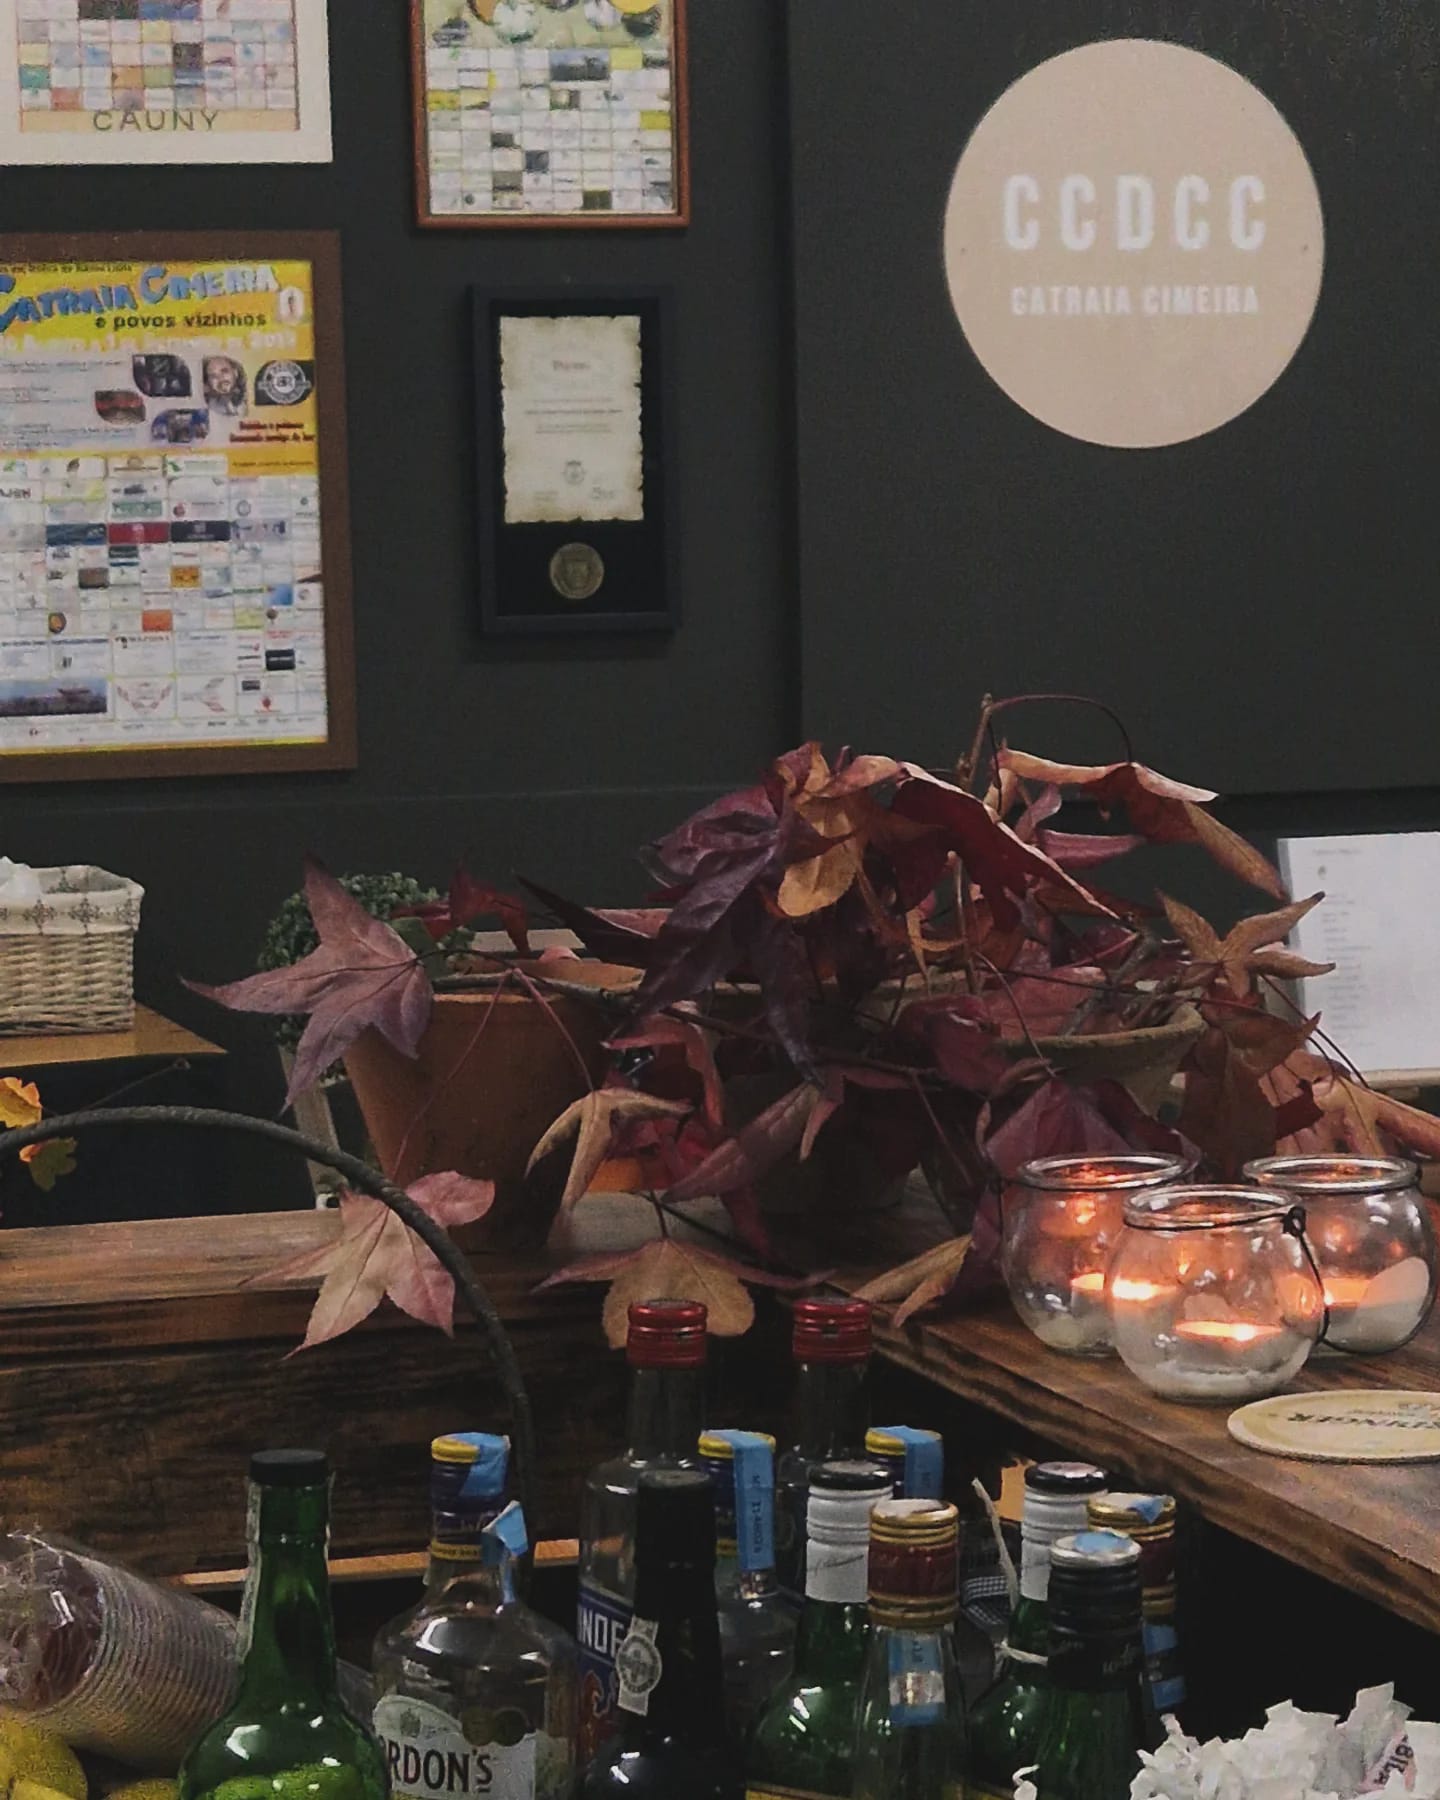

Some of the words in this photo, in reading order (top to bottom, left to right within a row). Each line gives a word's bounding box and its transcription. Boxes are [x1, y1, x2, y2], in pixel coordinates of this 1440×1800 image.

[93, 108, 219, 131] CAUNY
[1003, 173, 1266, 251] CCDCC
[1011, 285, 1131, 315] CATRAIA
[1143, 285, 1259, 315] CIMEIRA
[95, 316, 106, 328] e
[113, 315, 176, 331] povos
[184, 311, 267, 328] vizinhos
